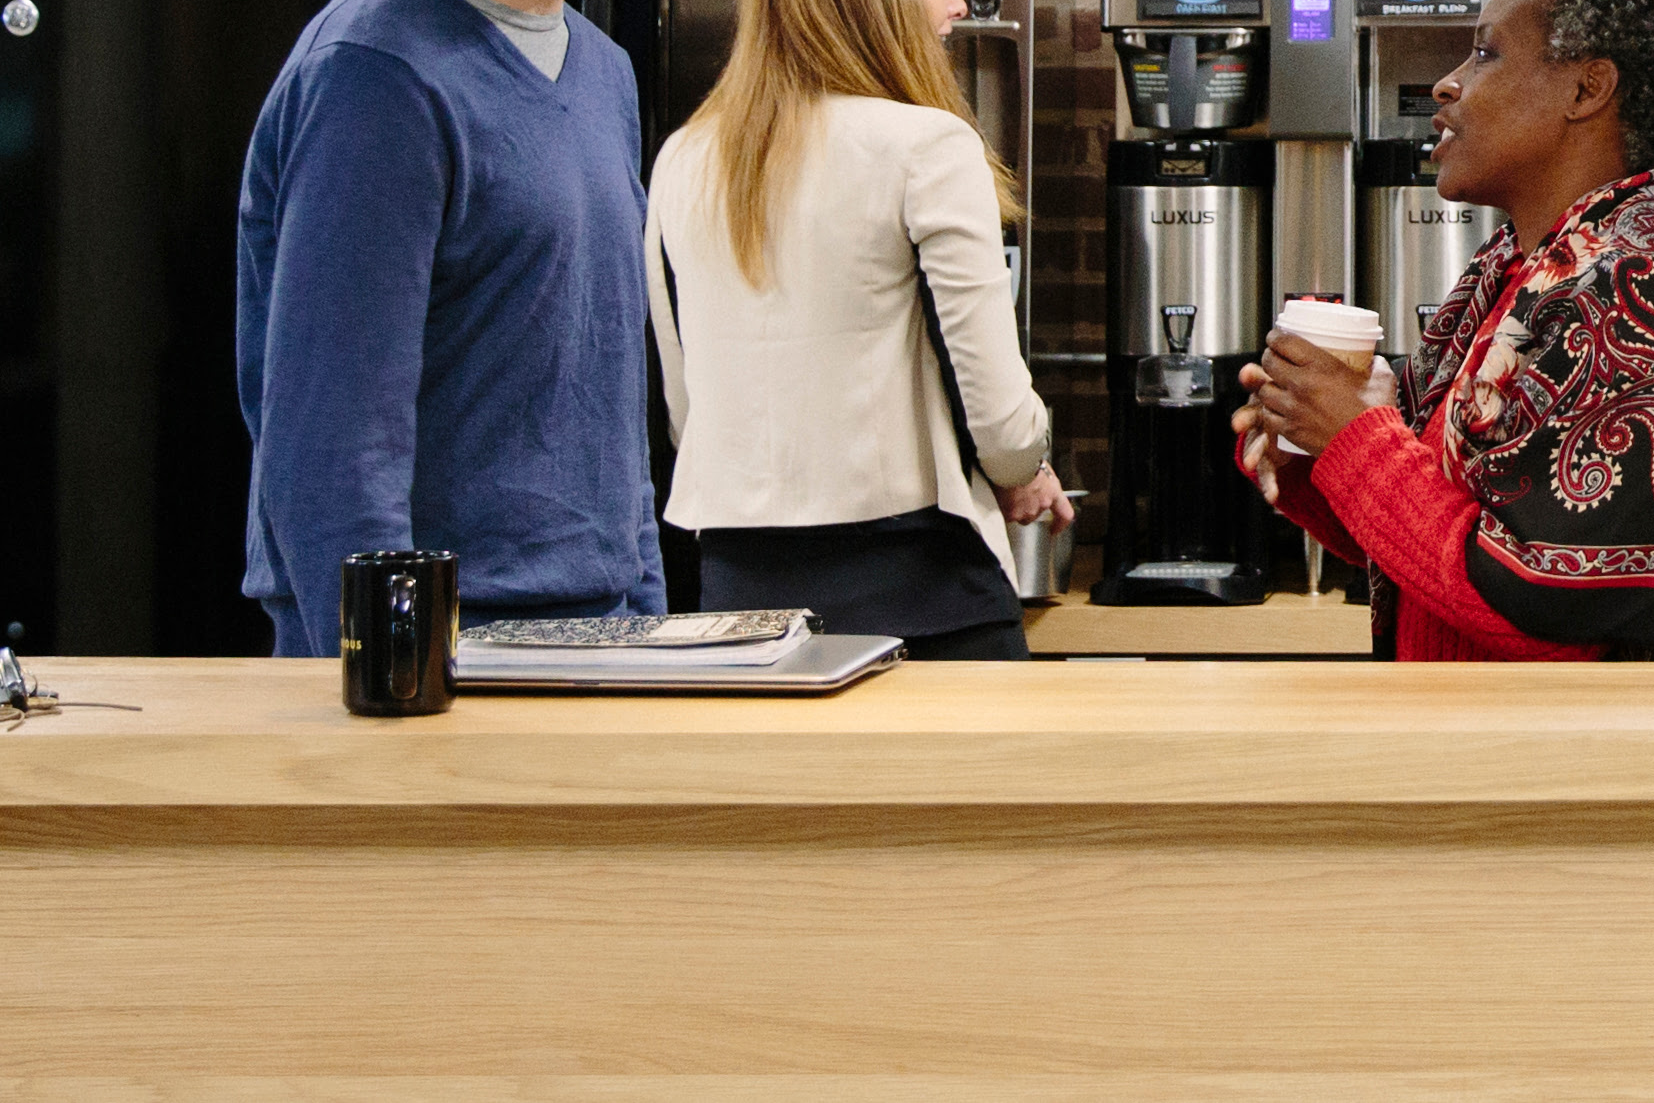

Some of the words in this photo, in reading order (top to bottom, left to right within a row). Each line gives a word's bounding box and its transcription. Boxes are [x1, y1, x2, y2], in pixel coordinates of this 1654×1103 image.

[1382, 4, 1435, 15] BREAKFAST
[1438, 4, 1469, 14] BLEND
[1151, 210, 1216, 224] LUXUS
[1408, 210, 1473, 224] LUXUS
[1165, 306, 1195, 315] FETCO
